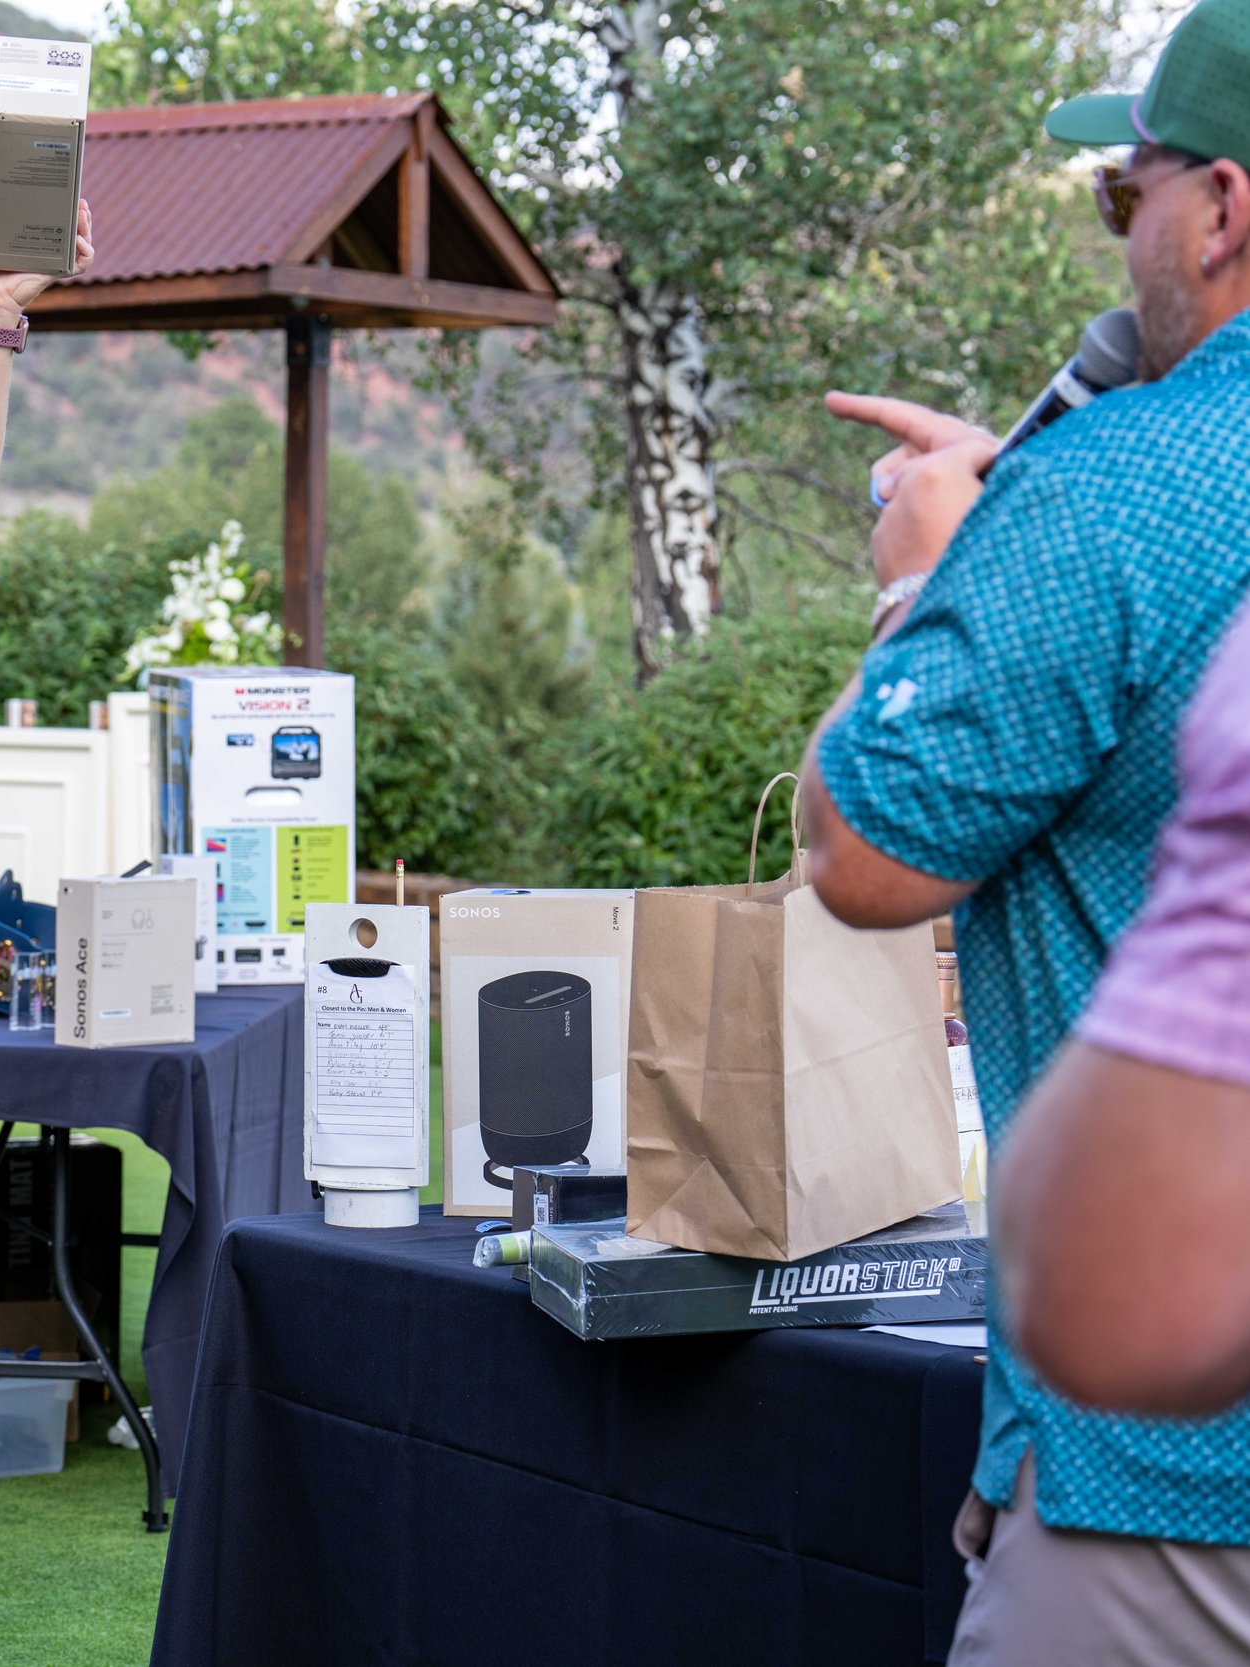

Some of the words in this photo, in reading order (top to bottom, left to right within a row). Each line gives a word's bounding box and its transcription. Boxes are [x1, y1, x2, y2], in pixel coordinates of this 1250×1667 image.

[238, 700, 292, 712] VISION
[297, 697, 310, 711] 2
[449, 907, 501, 919] SONOS
[75, 937, 89, 975] Ace
[317, 985, 328, 994] #8
[73, 978, 88, 1039] Sonos
[8, 1157, 34, 1206] MAT
[749, 1306, 773, 1315] PATENT
[773, 1305, 799, 1314] PENDING
